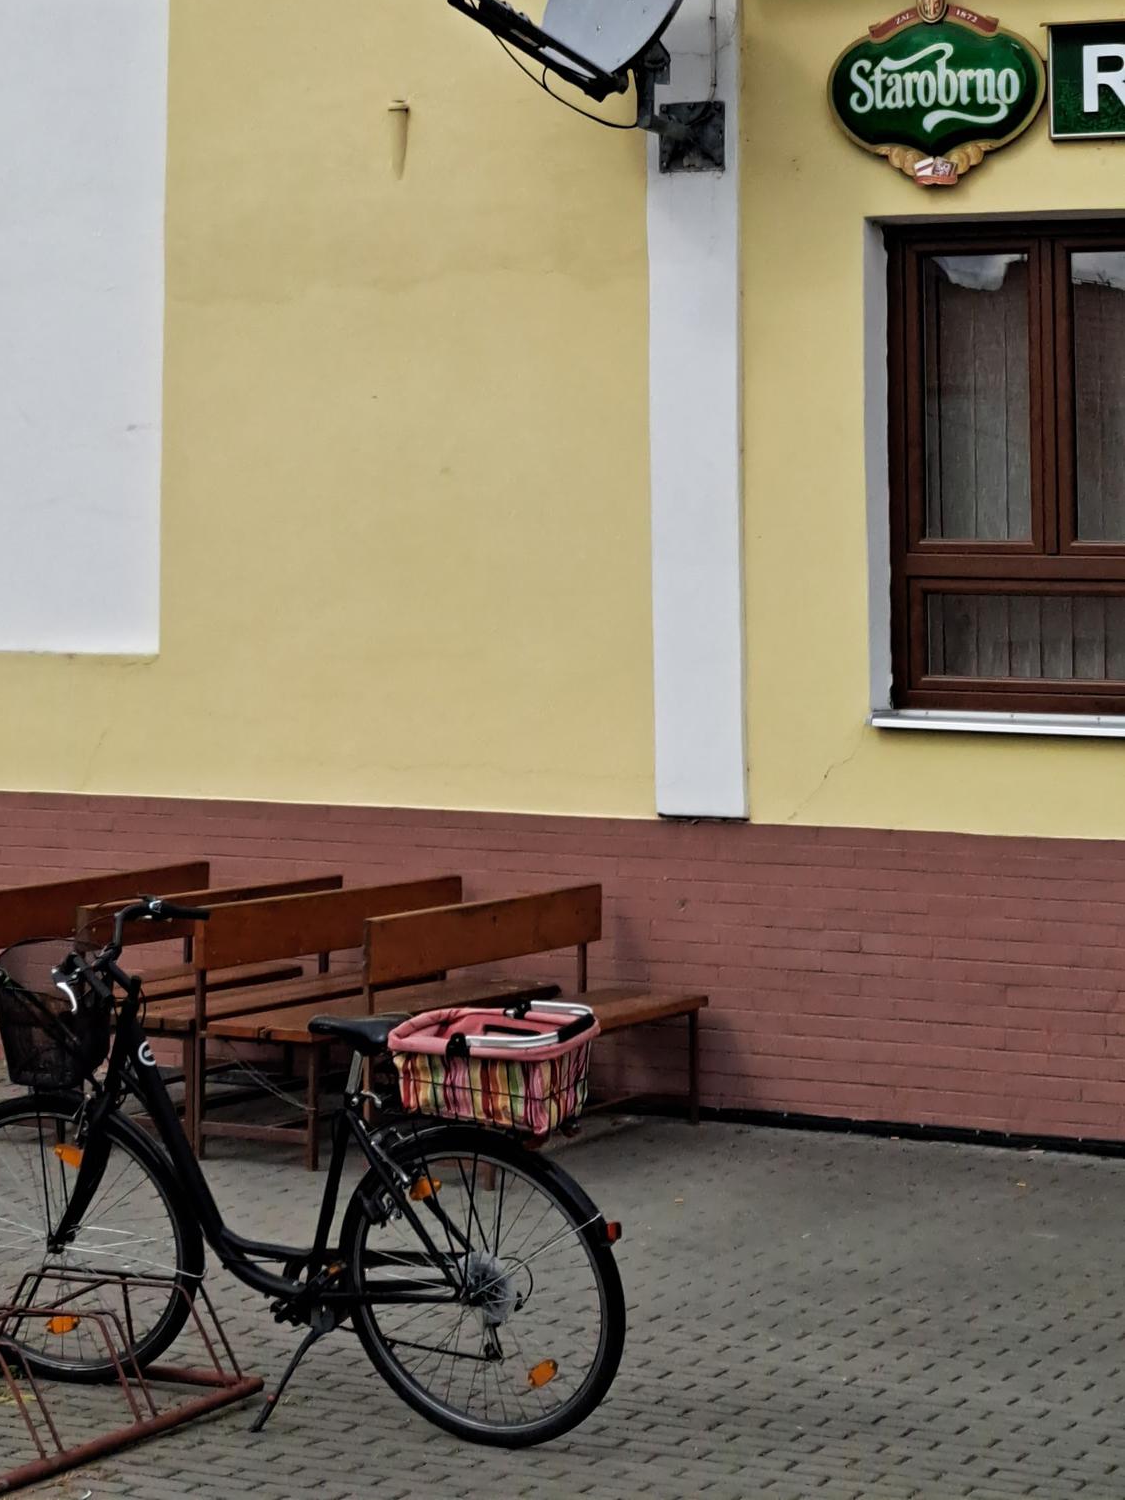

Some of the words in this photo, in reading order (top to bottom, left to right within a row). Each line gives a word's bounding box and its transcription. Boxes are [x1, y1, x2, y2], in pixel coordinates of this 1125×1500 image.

[955, 8, 979, 24] 1872
[849, 42, 1021, 134] Starobrno
[1082, 43, 1125, 113] R
